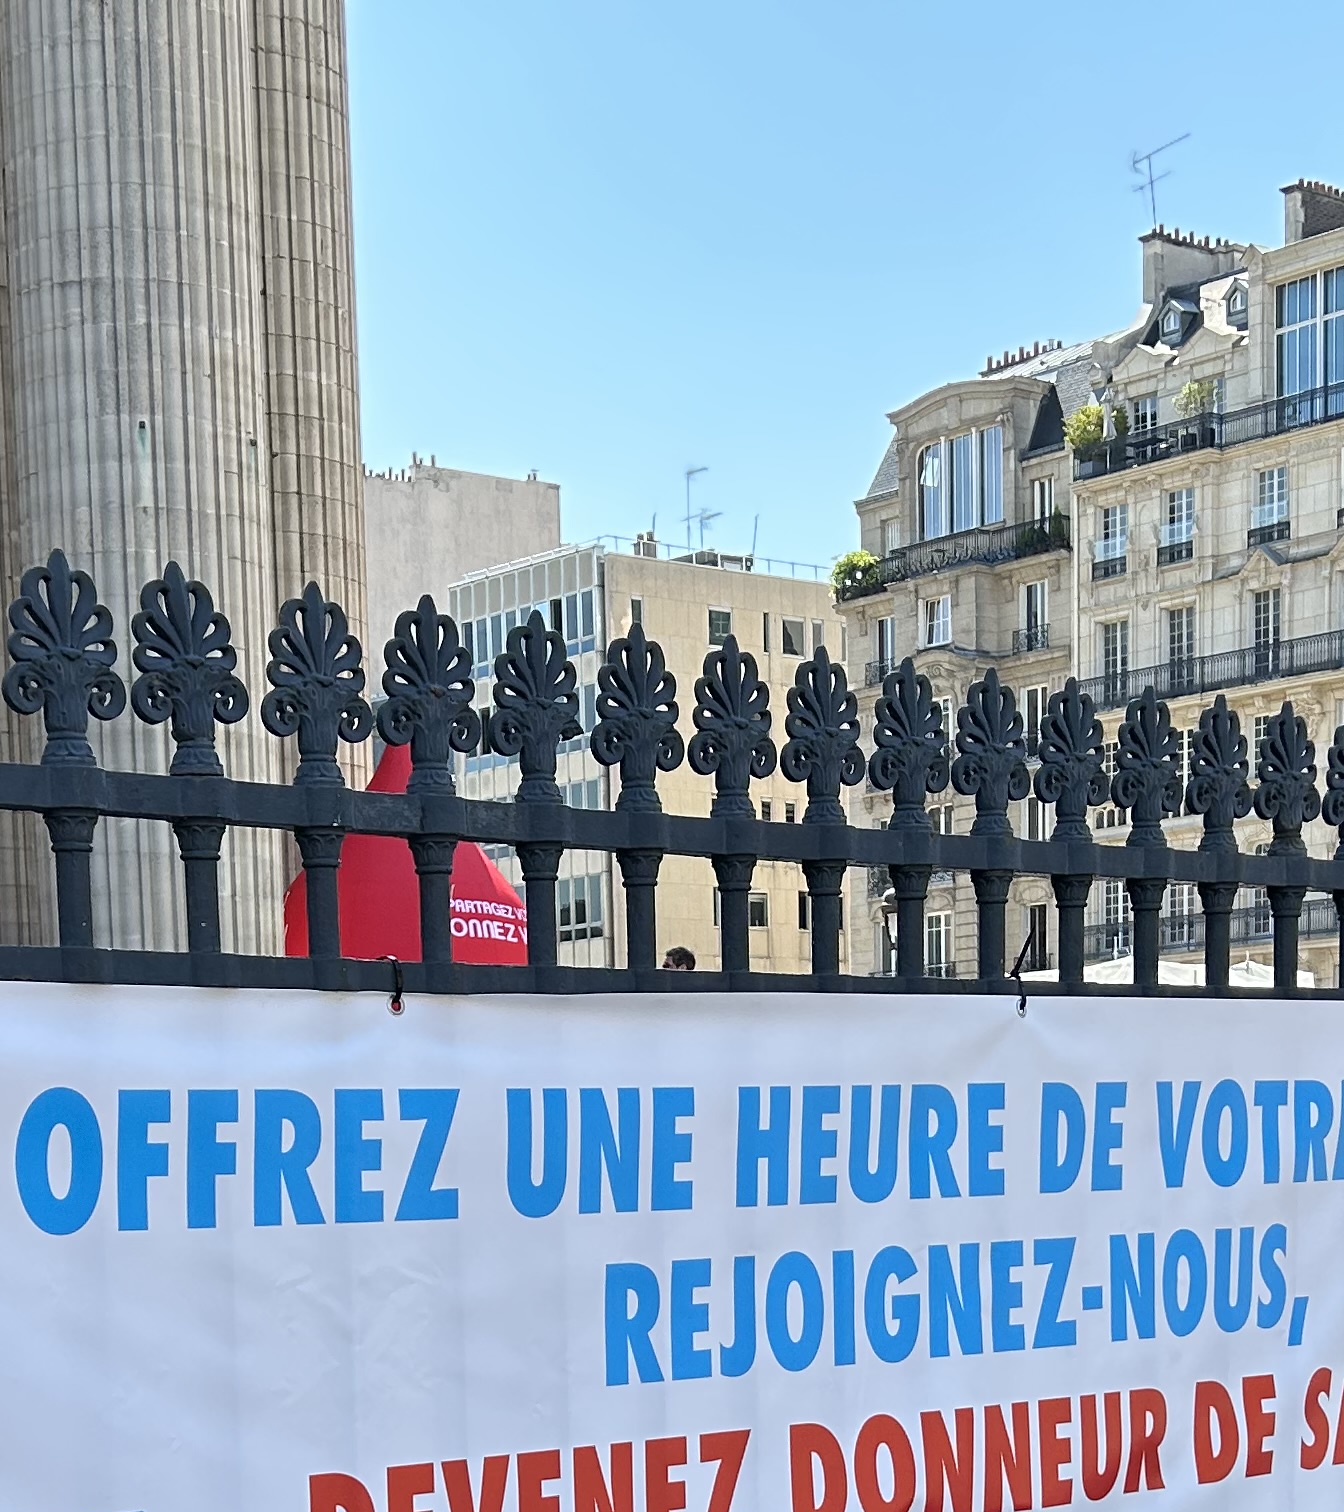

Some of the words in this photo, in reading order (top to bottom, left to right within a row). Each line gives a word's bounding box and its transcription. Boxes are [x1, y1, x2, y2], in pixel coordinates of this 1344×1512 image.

[450, 917, 518, 943] ONNEZ
[16, 1087, 459, 1236] OFFREZ
[507, 1085, 695, 1219] UNE
[736, 1082, 1006, 1208] HEURE
[1040, 1080, 1127, 1194] DE
[605, 1222, 1309, 1387] REJOIGNEZ-NOUS,
[1194, 1375, 1276, 1484] DE
